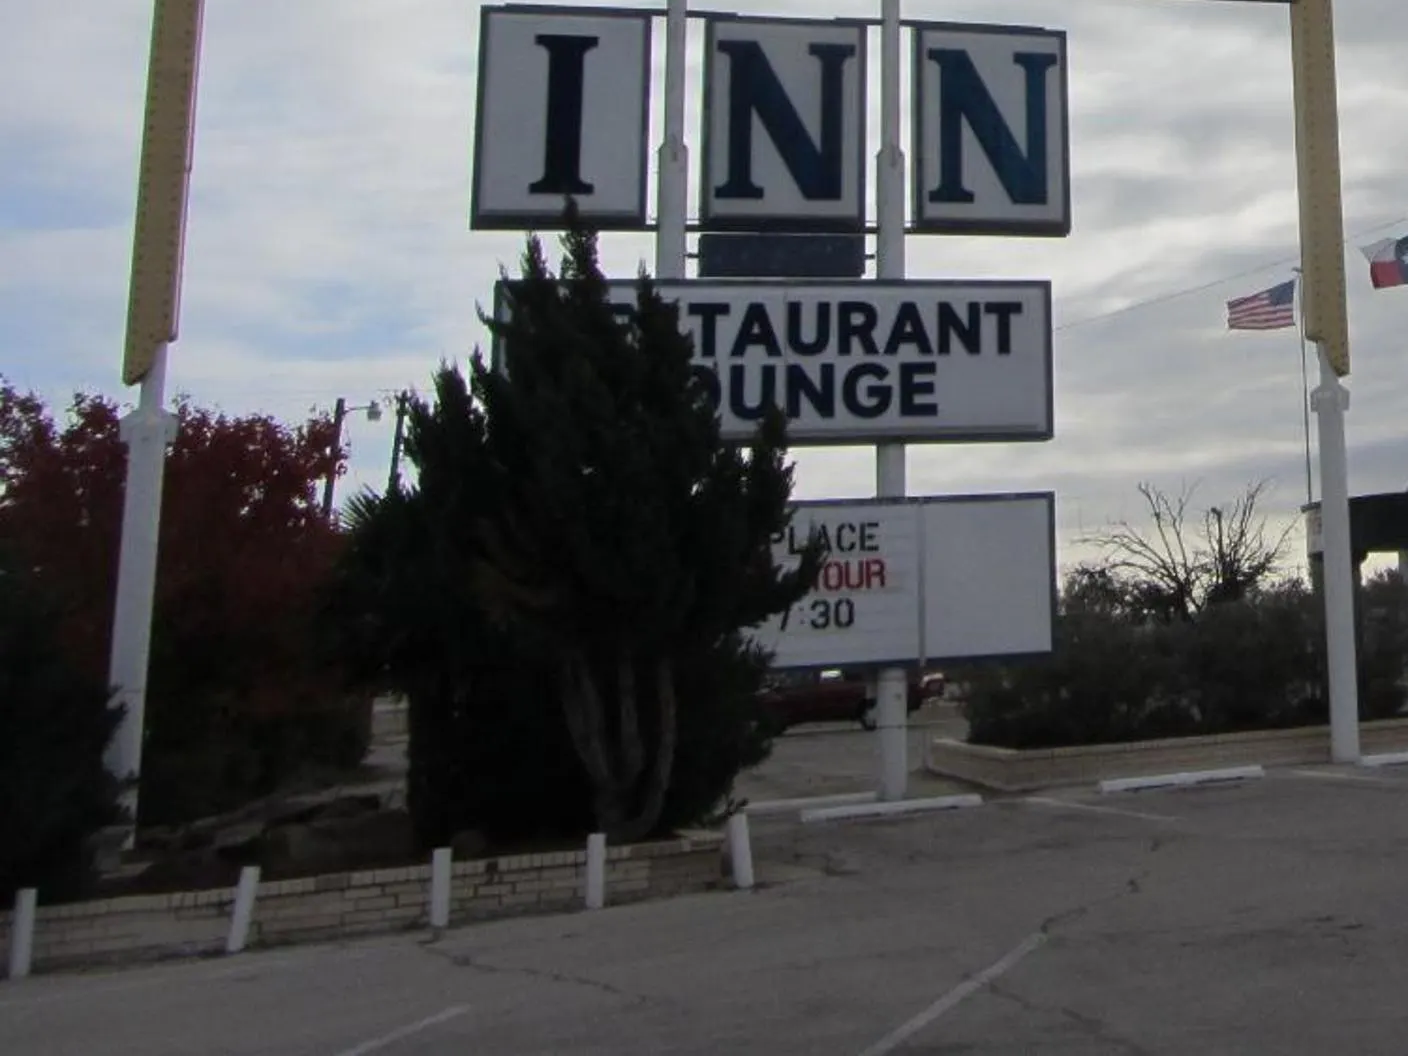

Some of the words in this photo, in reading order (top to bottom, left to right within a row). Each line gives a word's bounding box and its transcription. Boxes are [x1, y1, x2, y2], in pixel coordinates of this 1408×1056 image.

[528, 33, 1058, 205] INN
[606, 301, 1022, 357] TAURANT
[688, 361, 938, 420] UNGE
[814, 558, 886, 592] OUR
